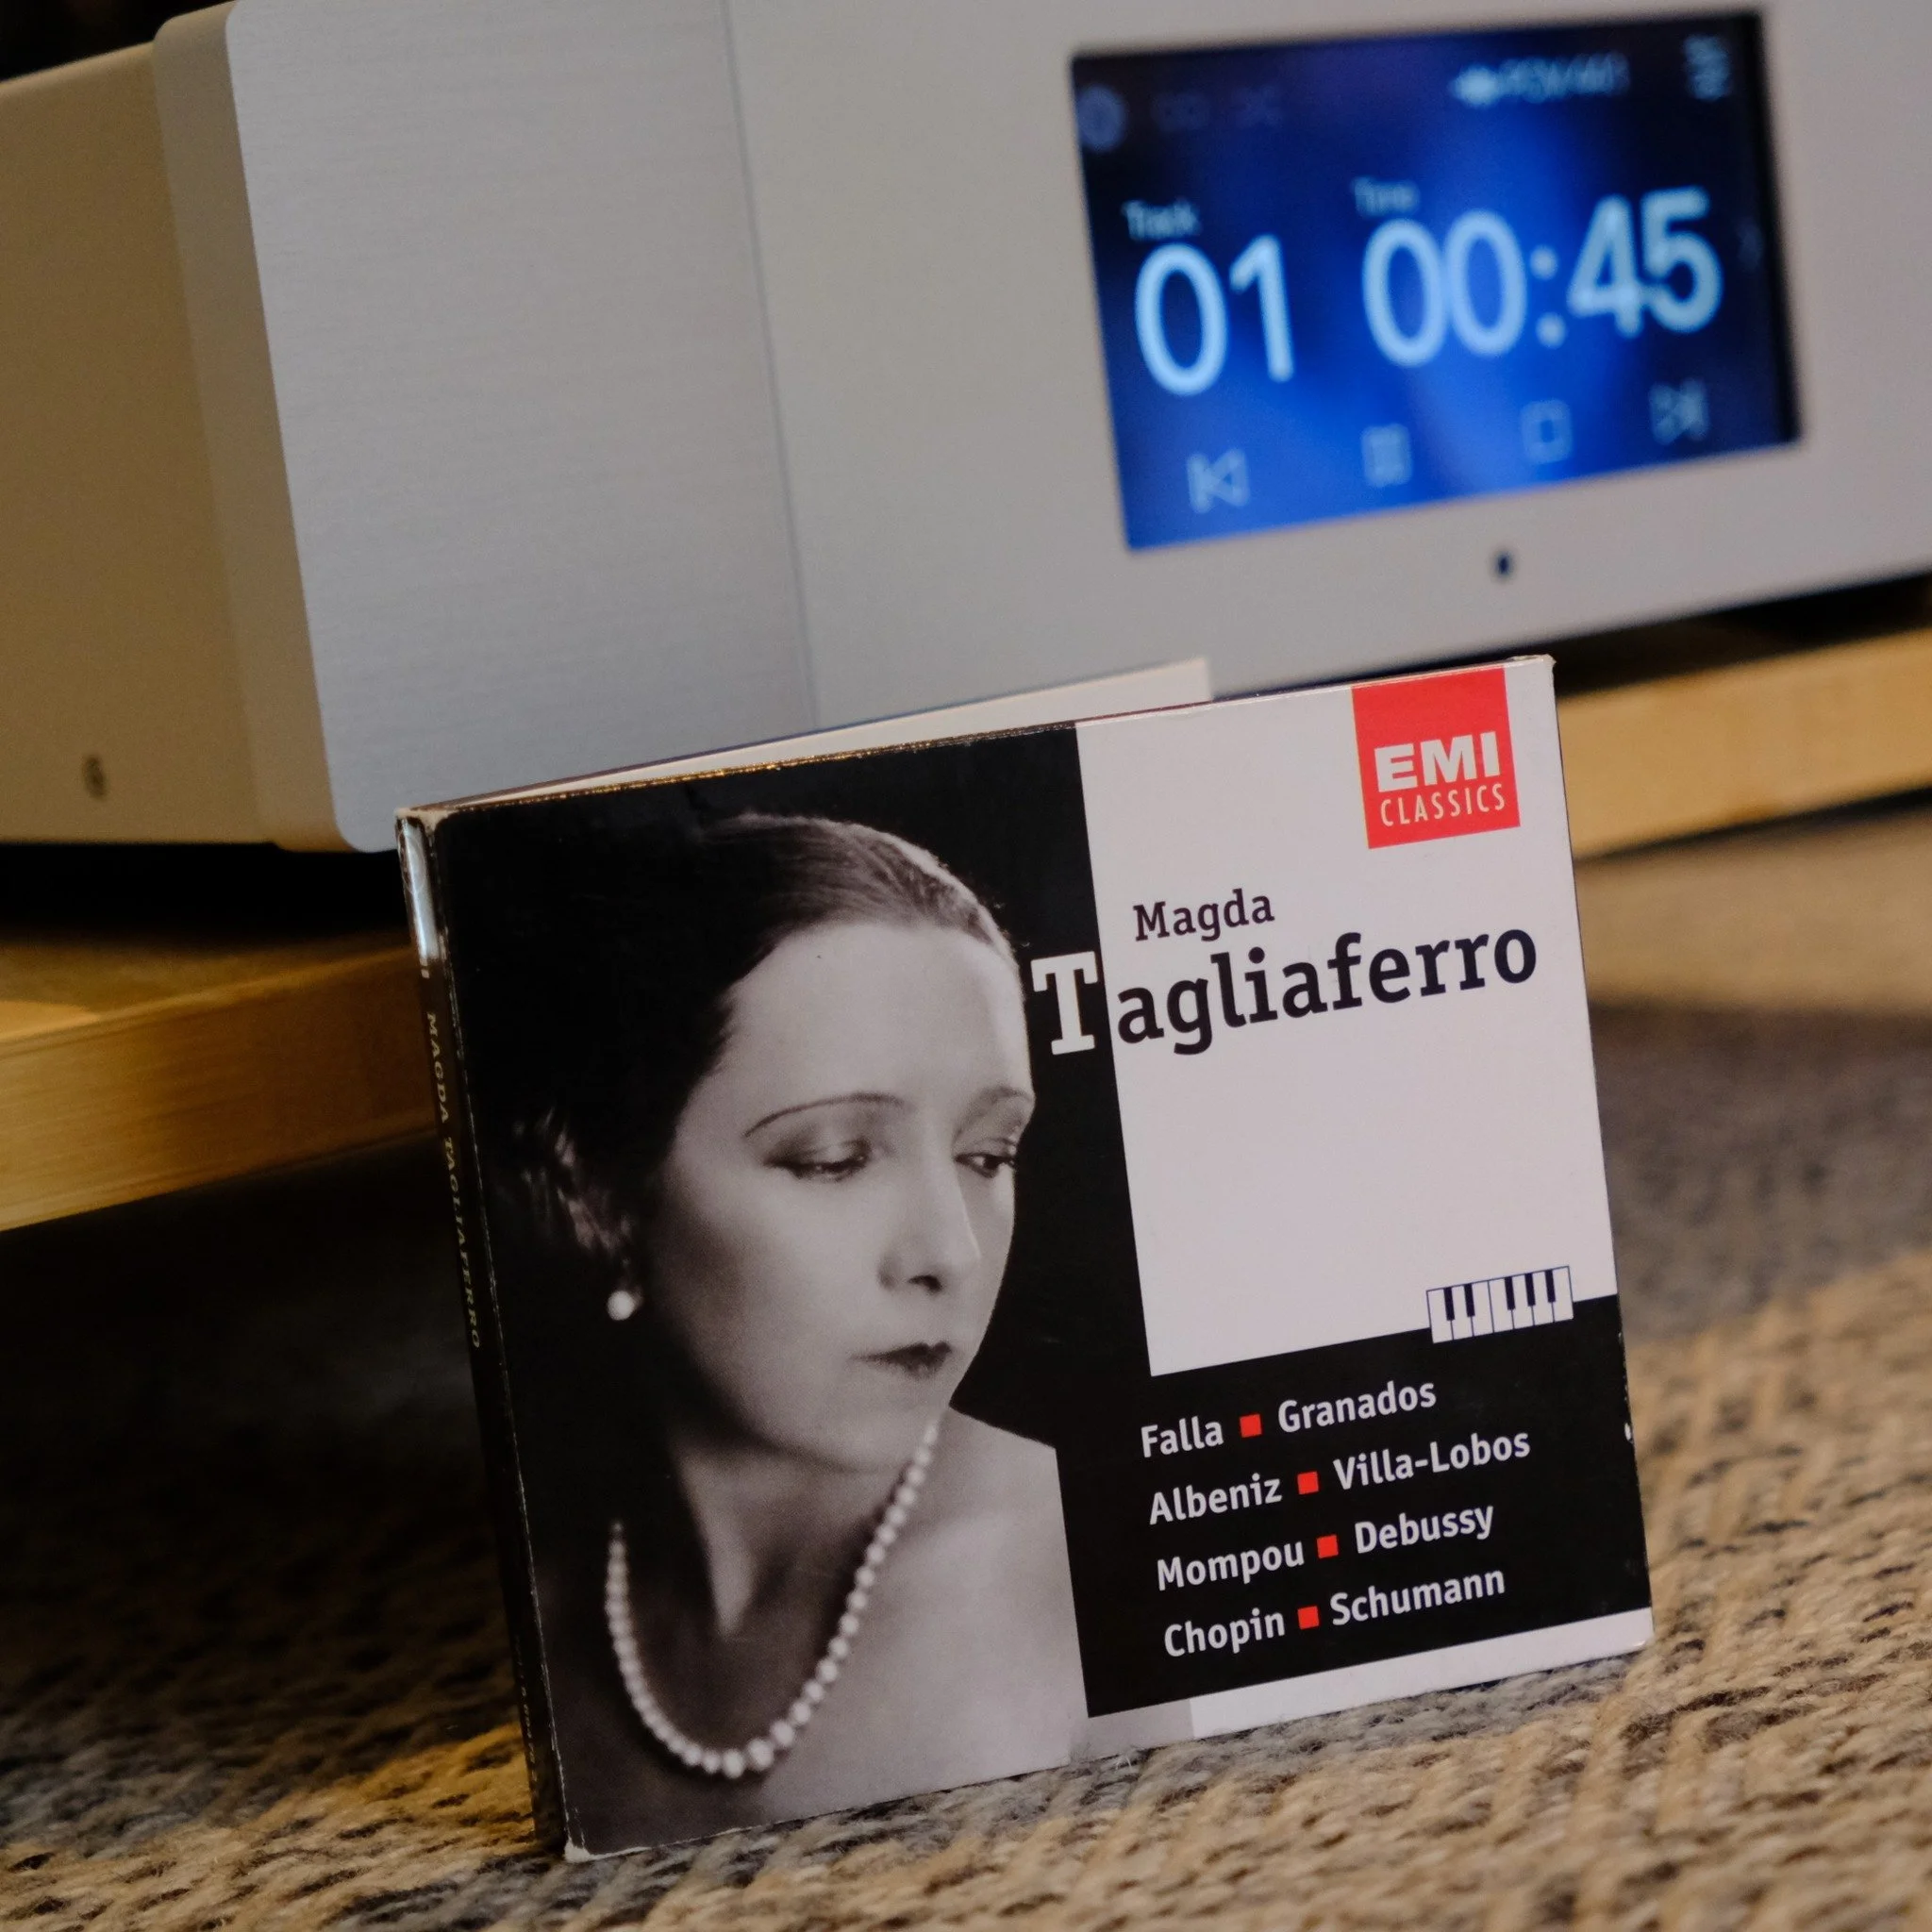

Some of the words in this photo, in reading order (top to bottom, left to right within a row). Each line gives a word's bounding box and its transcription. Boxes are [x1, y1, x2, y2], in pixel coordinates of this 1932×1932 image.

[1123, 201, 1200, 241] Track
[1134, 236, 1295, 396] 01
[1361, 188, 1723, 367] 00:45
[1374, 731, 1501, 792] EMI
[1380, 783, 1507, 827] CLASSICS
[1133, 889, 1275, 941] Magda
[1031, 928, 1537, 1056] Tagliaferro
[426, 1011, 449, 1124] MAGDA
[444, 1136, 480, 1349] TAGLIAFERRO
[1141, 1417, 1224, 1457] Falla
[1278, 1381, 1437, 1433] Granados
[1149, 1474, 1282, 1525] Albeniz
[1333, 1431, 1530, 1491] Villa-Lobos
[1157, 1541, 1305, 1591] Mompou
[1355, 1506, 1494, 1555] Debussy
[1163, 1608, 1286, 1657] Chopin
[1329, 1569, 1506, 1626] Schumann
